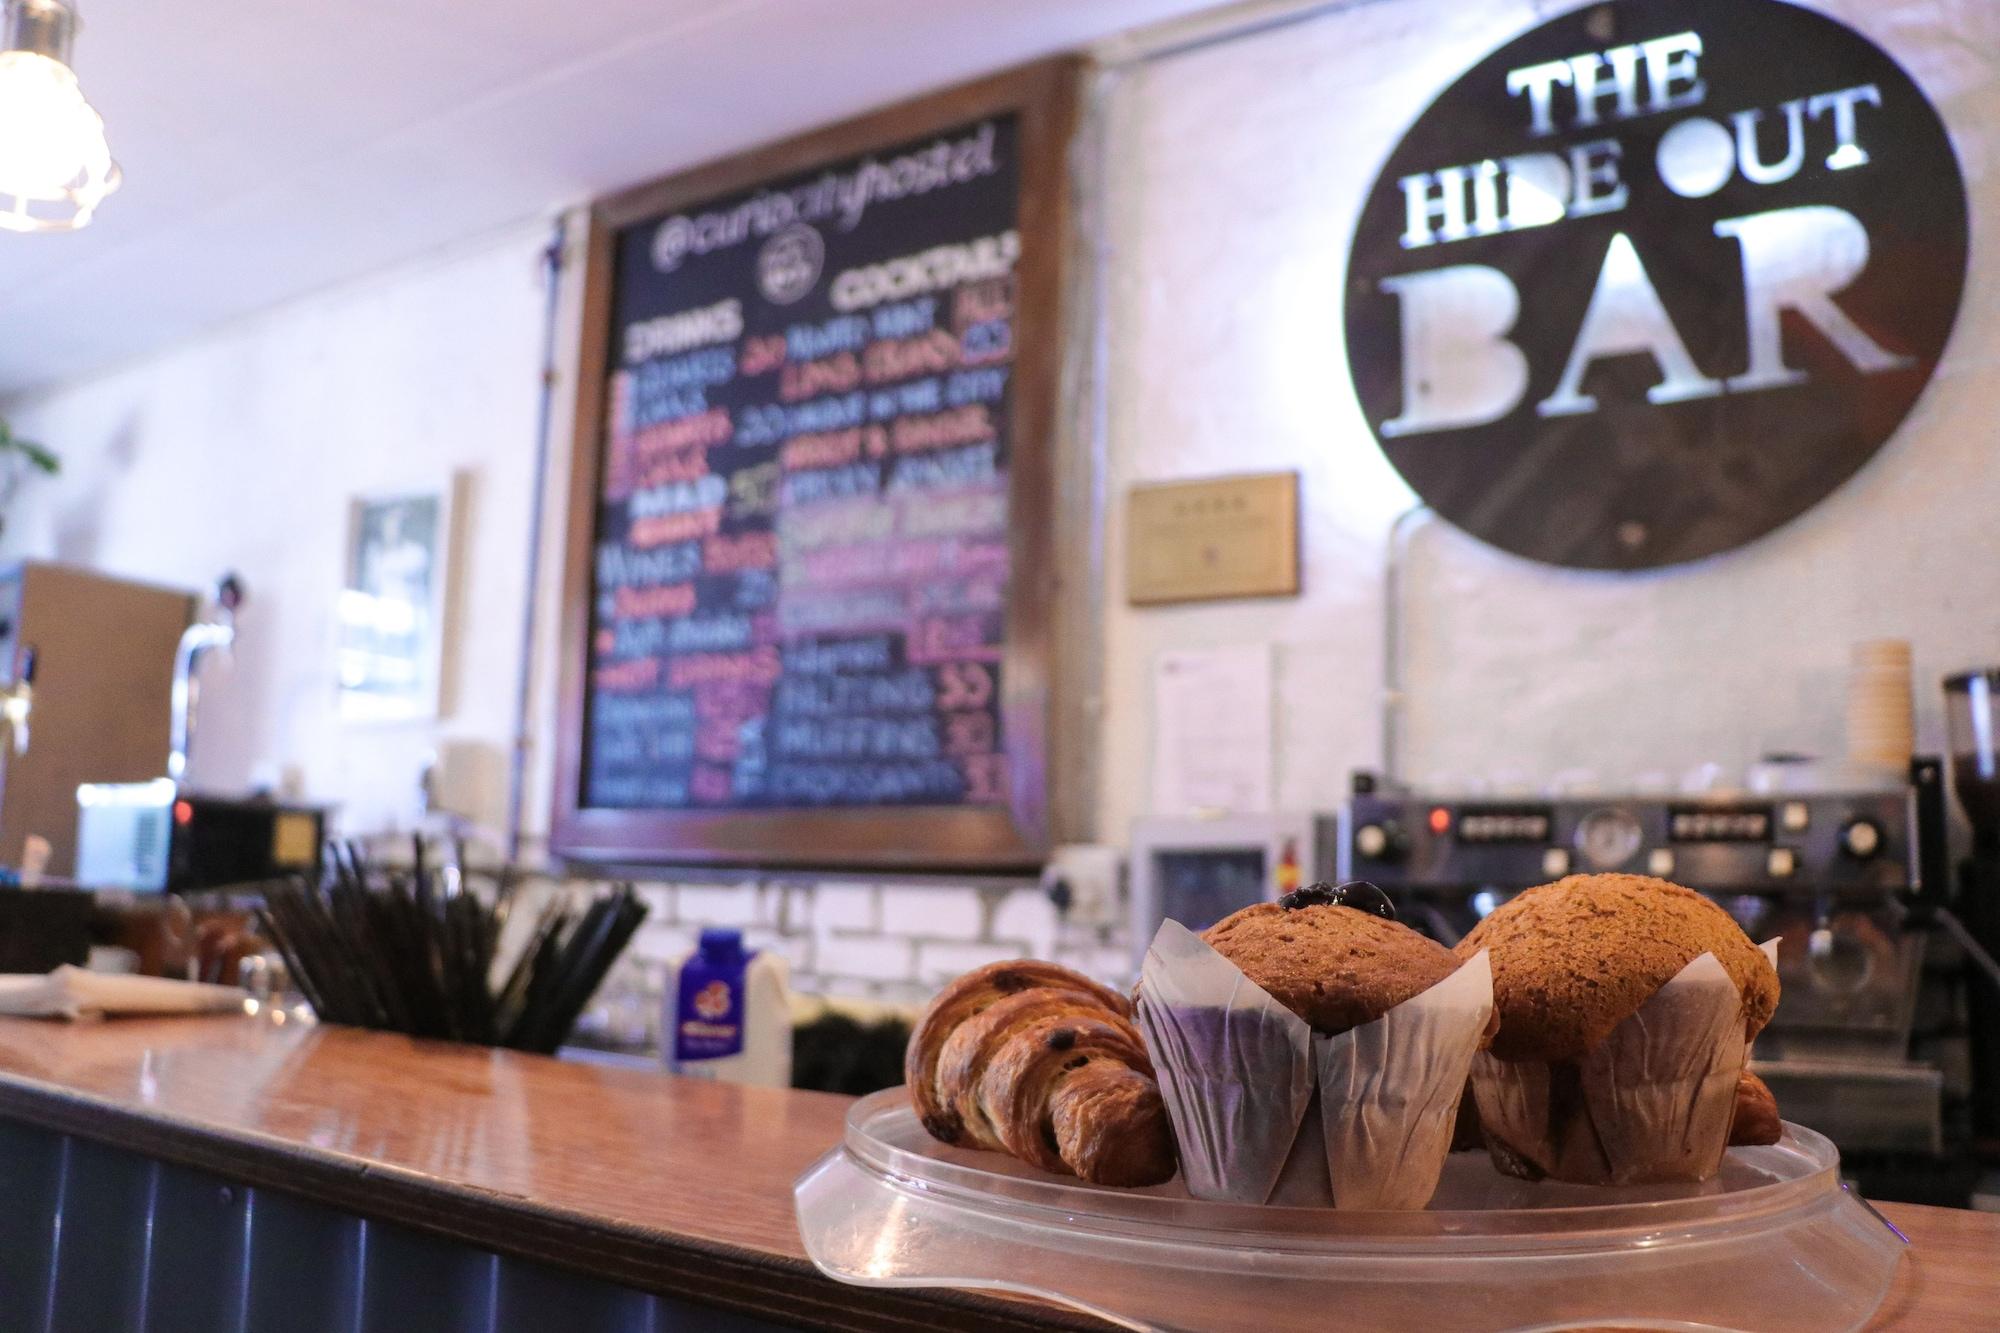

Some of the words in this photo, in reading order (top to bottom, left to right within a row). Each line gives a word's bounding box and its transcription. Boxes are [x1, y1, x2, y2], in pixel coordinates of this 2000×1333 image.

[1400, 139, 1628, 249] HIDE
[1656, 84, 1882, 198] OUT
[1506, 31, 1706, 137] THE
[1379, 205, 1918, 437] BAR
